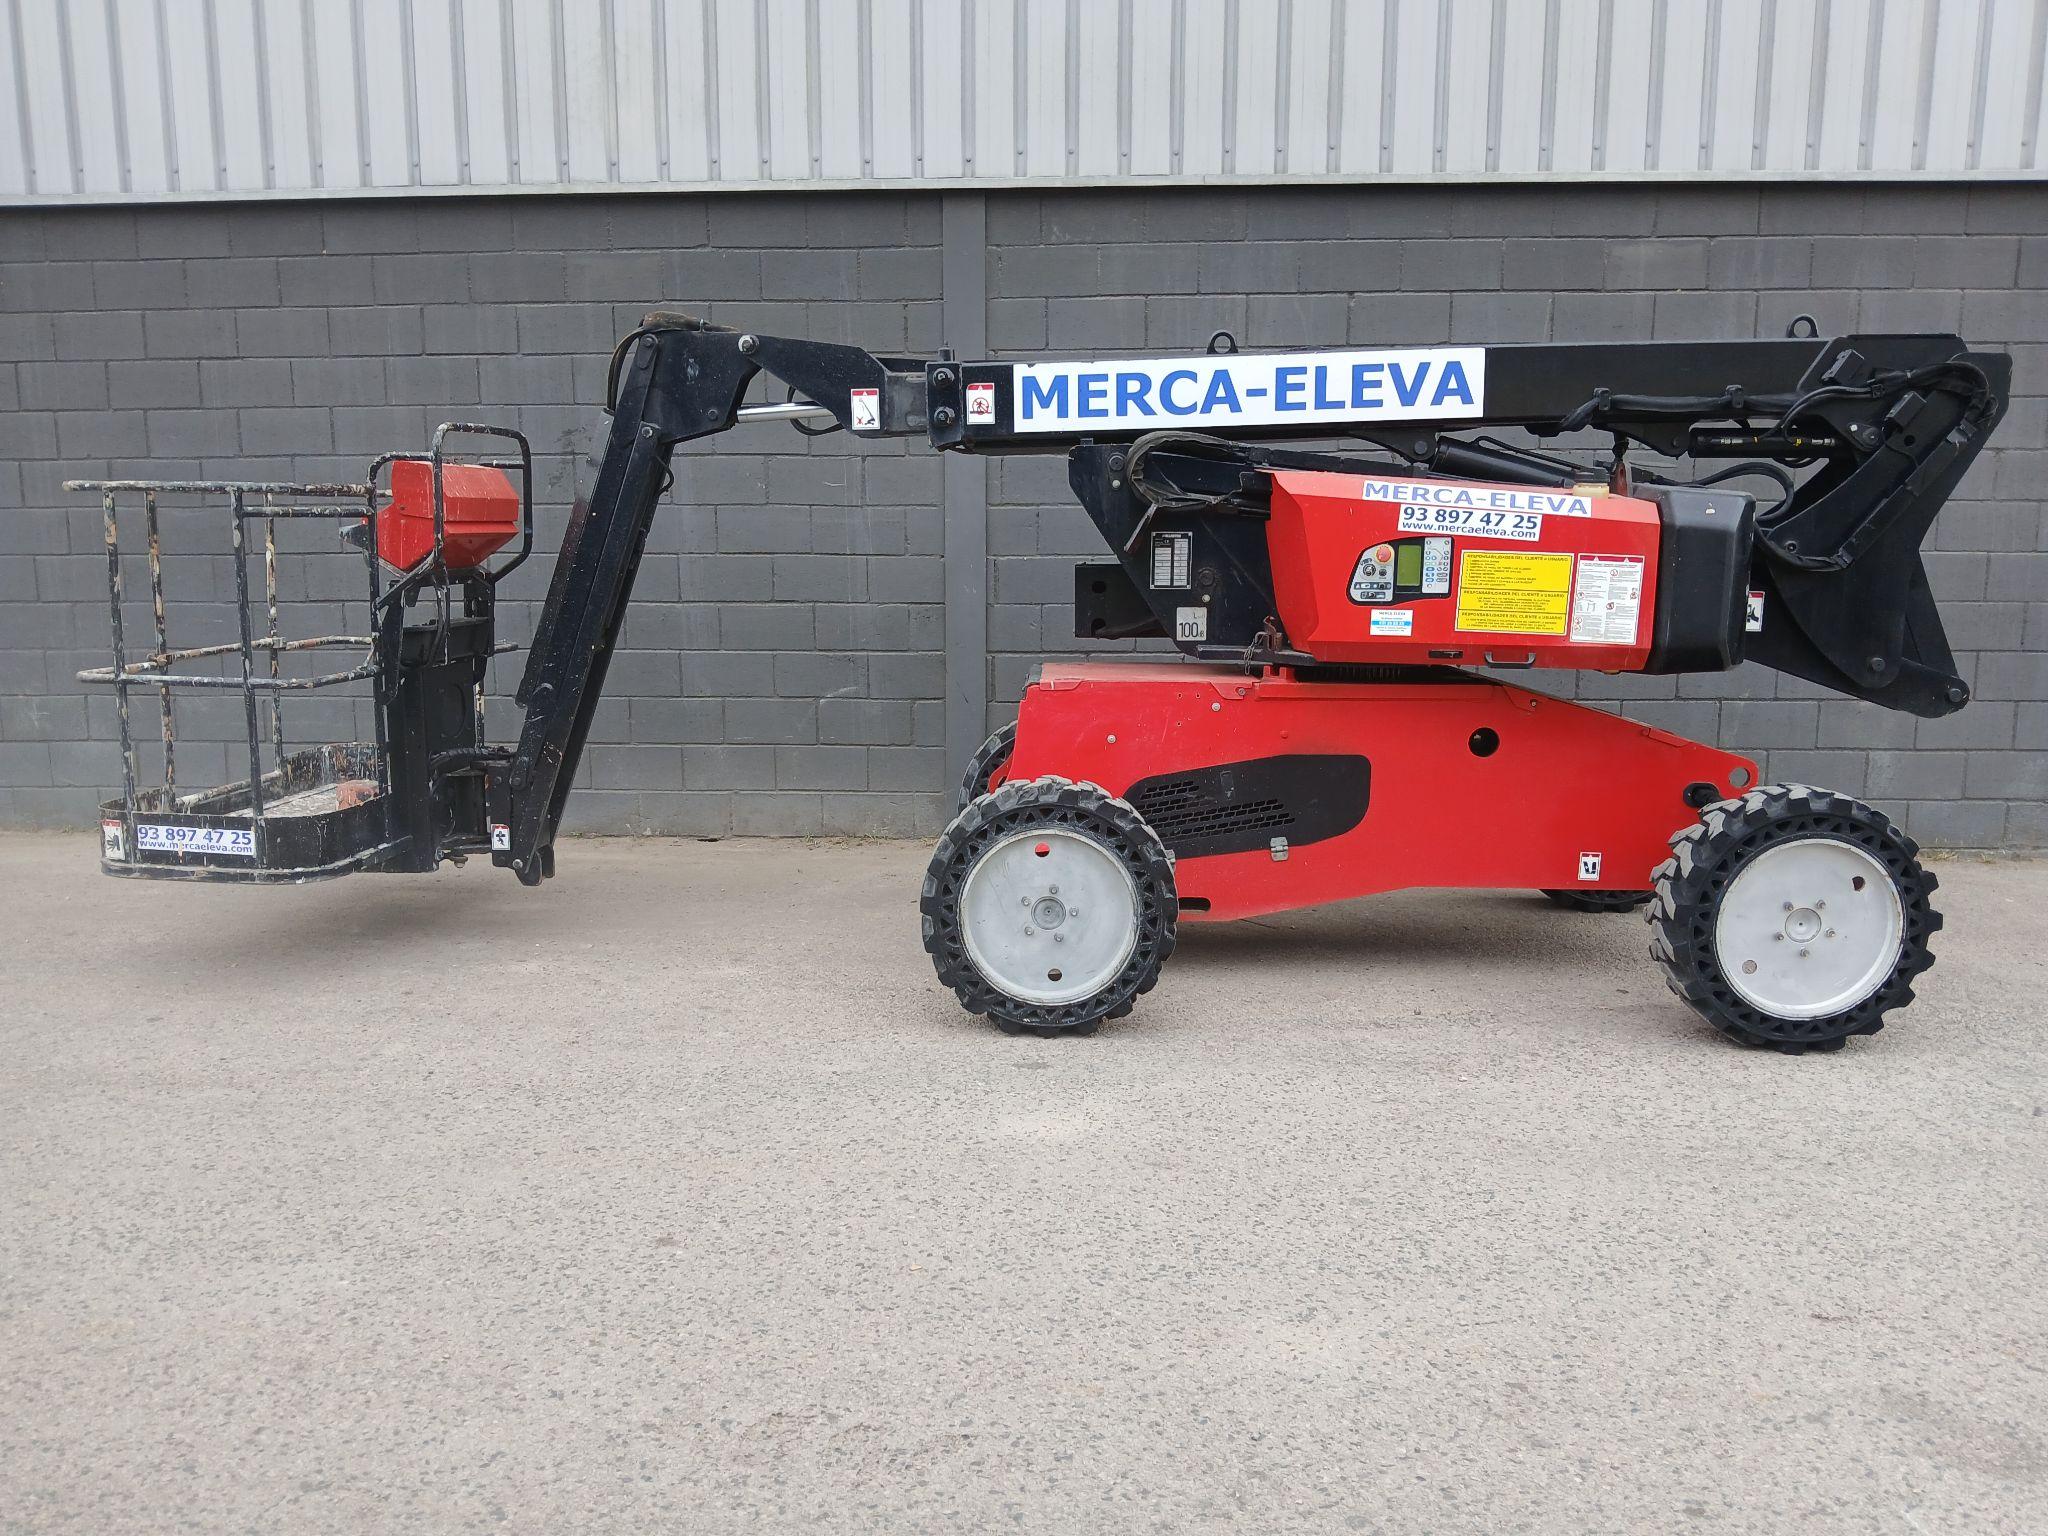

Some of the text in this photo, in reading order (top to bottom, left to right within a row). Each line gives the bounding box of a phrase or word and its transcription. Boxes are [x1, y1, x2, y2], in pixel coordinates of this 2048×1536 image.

[1021, 360, 1475, 420] MERCA-ELEVA
[1364, 483, 1588, 515] MERCA-ELEVA
[1403, 506, 1538, 530] 93 897 47 25
[1402, 521, 1536, 539] www.mercaeleva.com
[1179, 622, 1198, 638] 100
[138, 826, 252, 845] 93 897 47 25
